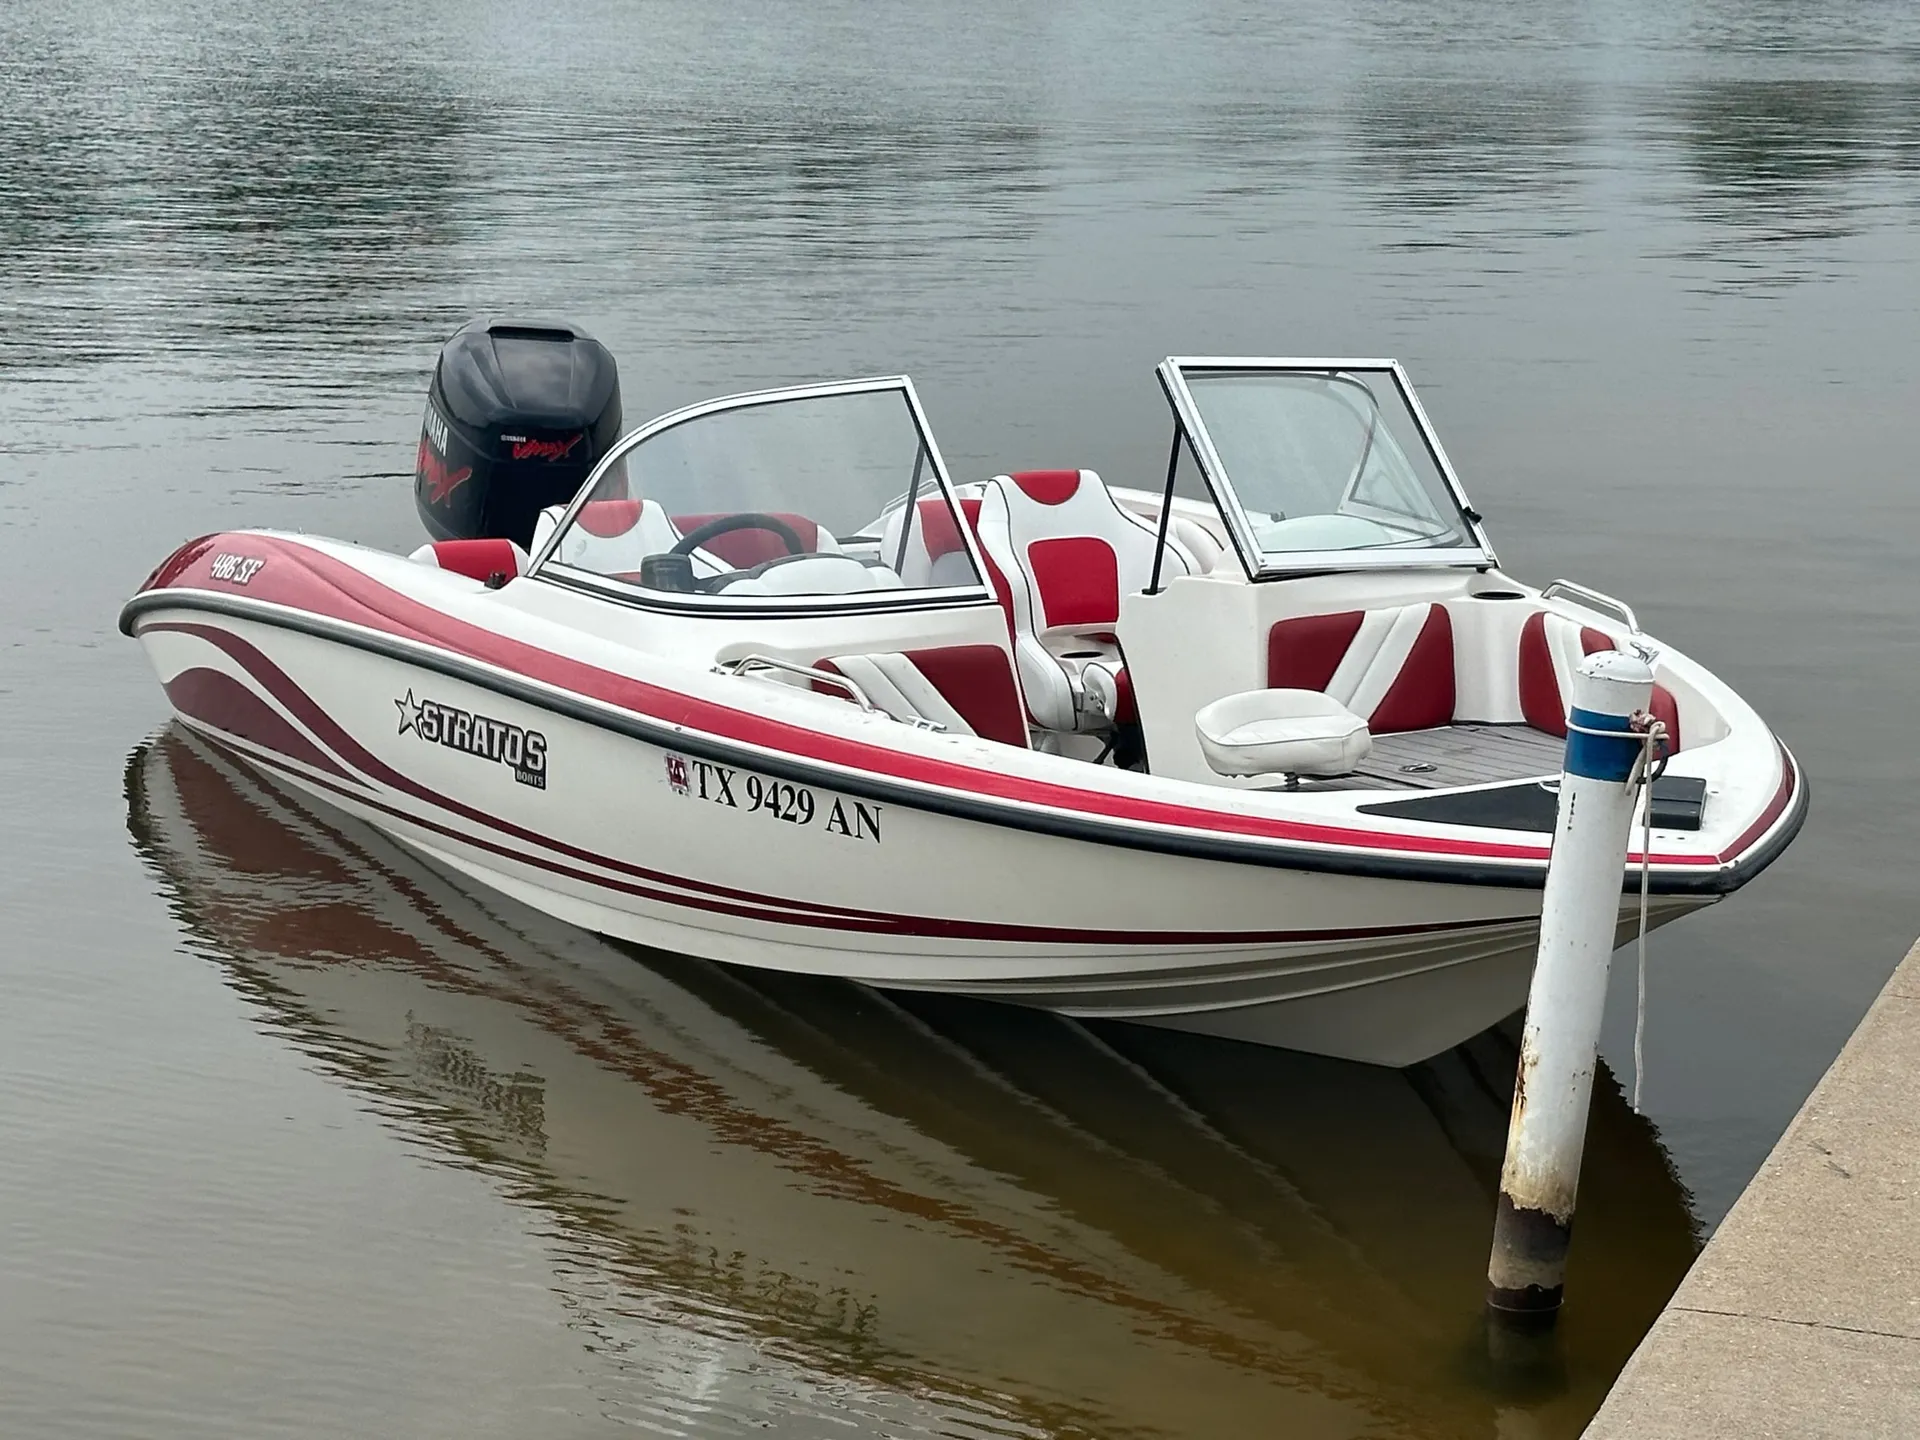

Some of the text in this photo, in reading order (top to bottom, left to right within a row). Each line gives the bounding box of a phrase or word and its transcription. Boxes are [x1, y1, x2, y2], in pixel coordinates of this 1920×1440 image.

[210, 553, 266, 584] 486 SF
[421, 700, 547, 773] STRATOS
[516, 770, 544, 787] BOATS
[692, 760, 738, 808] TX
[746, 775, 815, 825] 9429
[826, 797, 883, 843] AN
